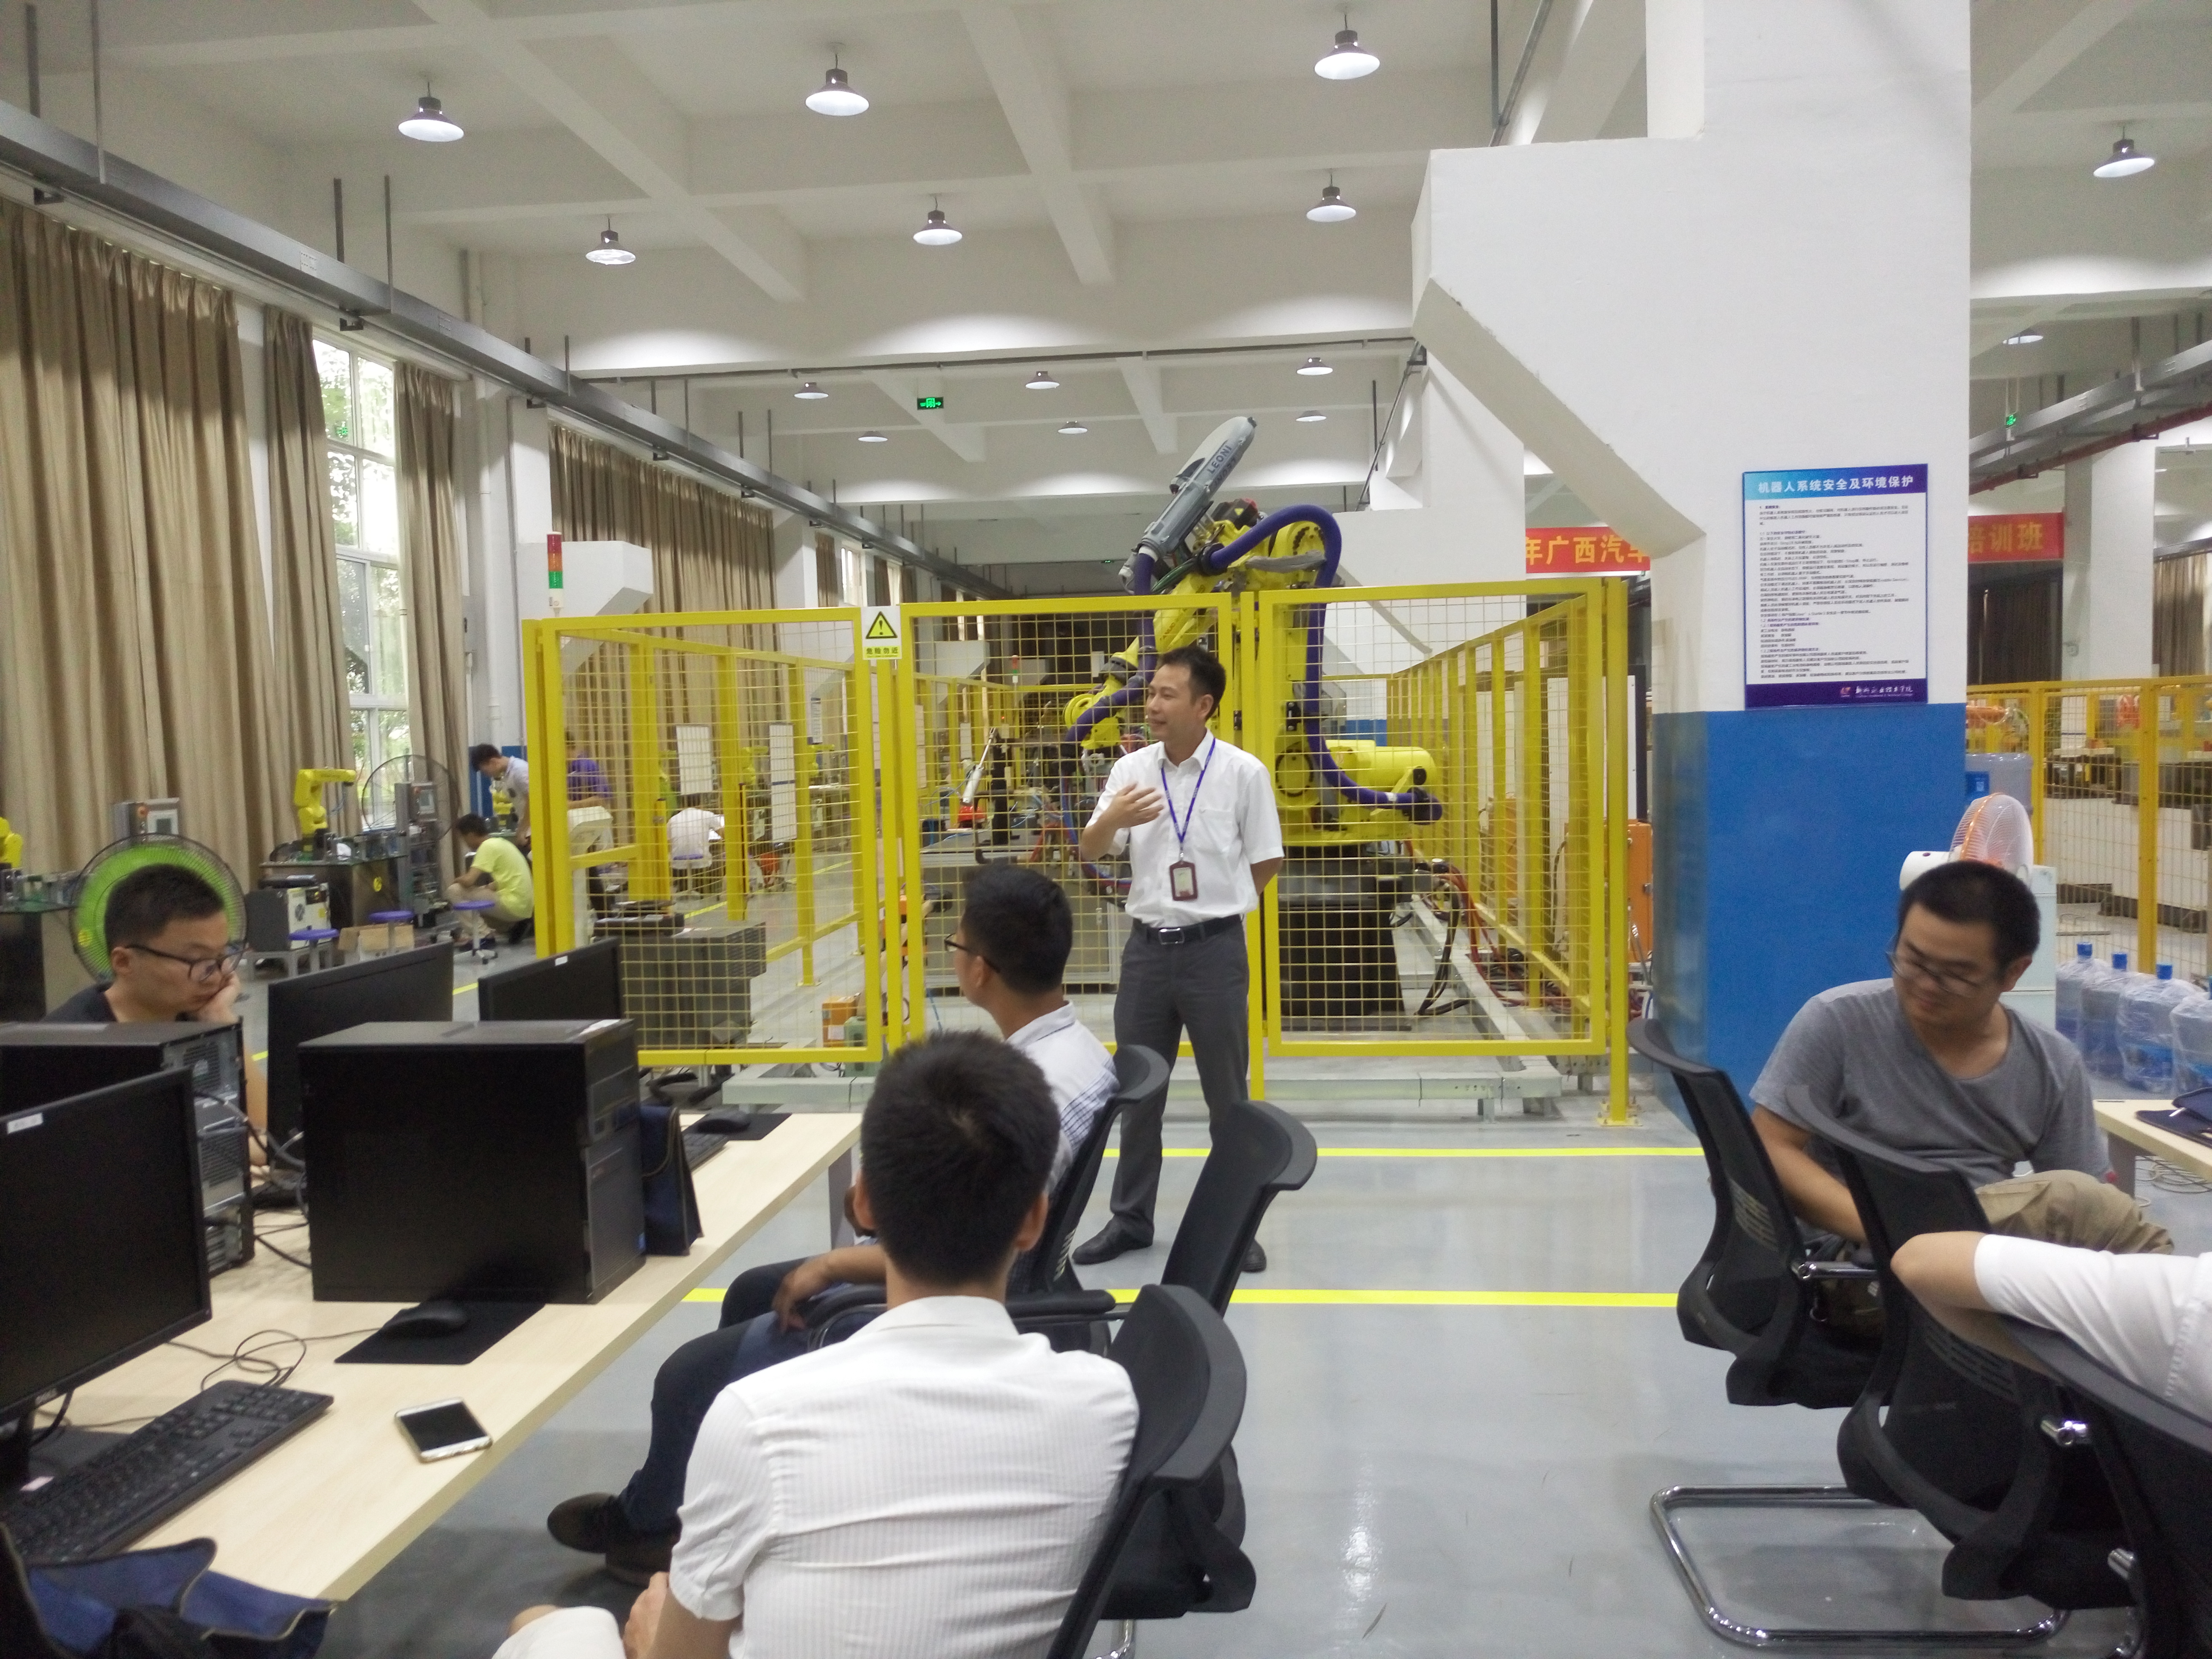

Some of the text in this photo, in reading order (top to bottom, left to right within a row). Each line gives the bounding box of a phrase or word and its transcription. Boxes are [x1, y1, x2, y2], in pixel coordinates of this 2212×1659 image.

[1206, 445, 1232, 474] LEONI
[1758, 475, 1913, 493] 机器人系统安全及环境保护
